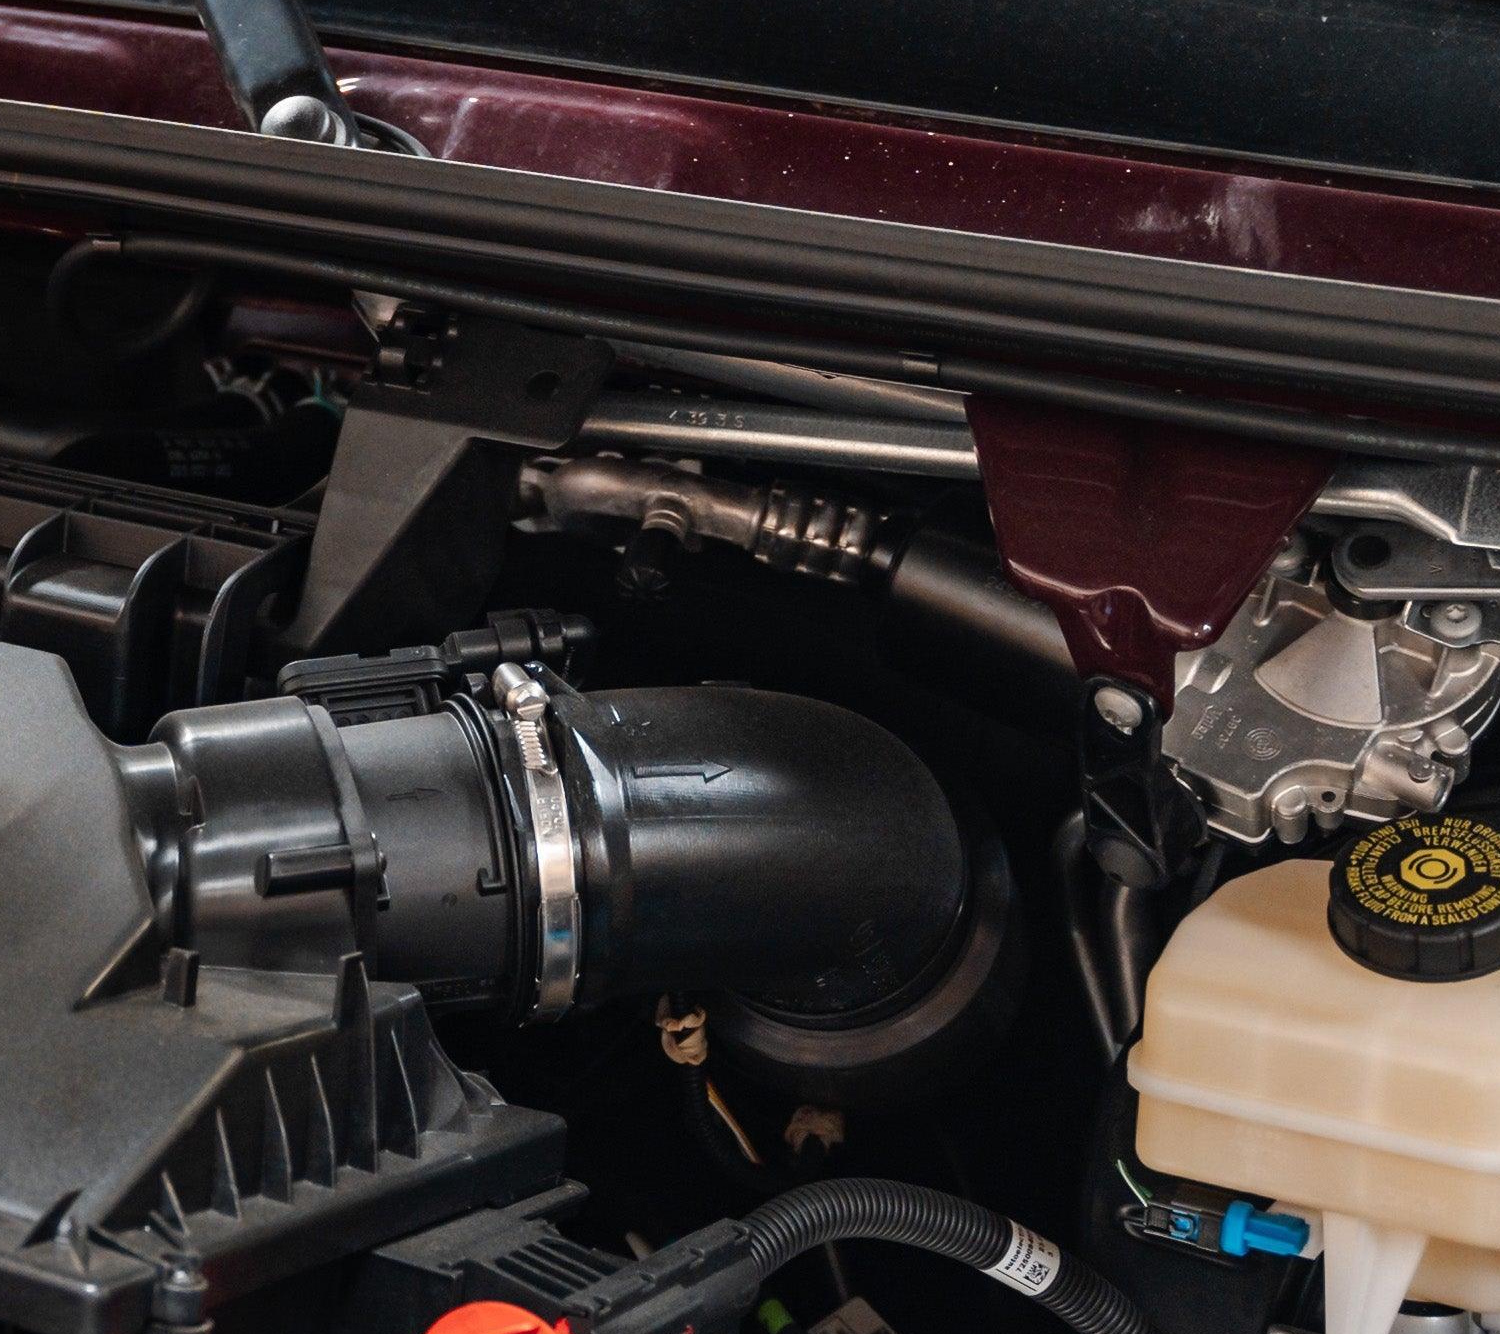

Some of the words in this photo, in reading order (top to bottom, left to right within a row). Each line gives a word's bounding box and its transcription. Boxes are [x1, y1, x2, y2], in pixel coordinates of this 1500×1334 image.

[1369, 824, 1396, 844] ONLY
[1397, 818, 1421, 831] USE
[1443, 817, 1472, 830] NUR
[1369, 833, 1401, 857] CLEAN
[1423, 836, 1488, 873] VERWENDEN
[1346, 867, 1364, 892] BRAKE
[1361, 856, 1378, 885] FILLER
[1368, 884, 1391, 899] CAP
[1381, 874, 1429, 904] WARNING
[1438, 884, 1496, 914] REMOVING
[1356, 889, 1386, 913] FLUID
[1386, 893, 1434, 915] BEFORE
[1382, 908, 1419, 925] FROM
[1420, 914, 1429, 926] A
[1431, 906, 1479, 926] SEALED
